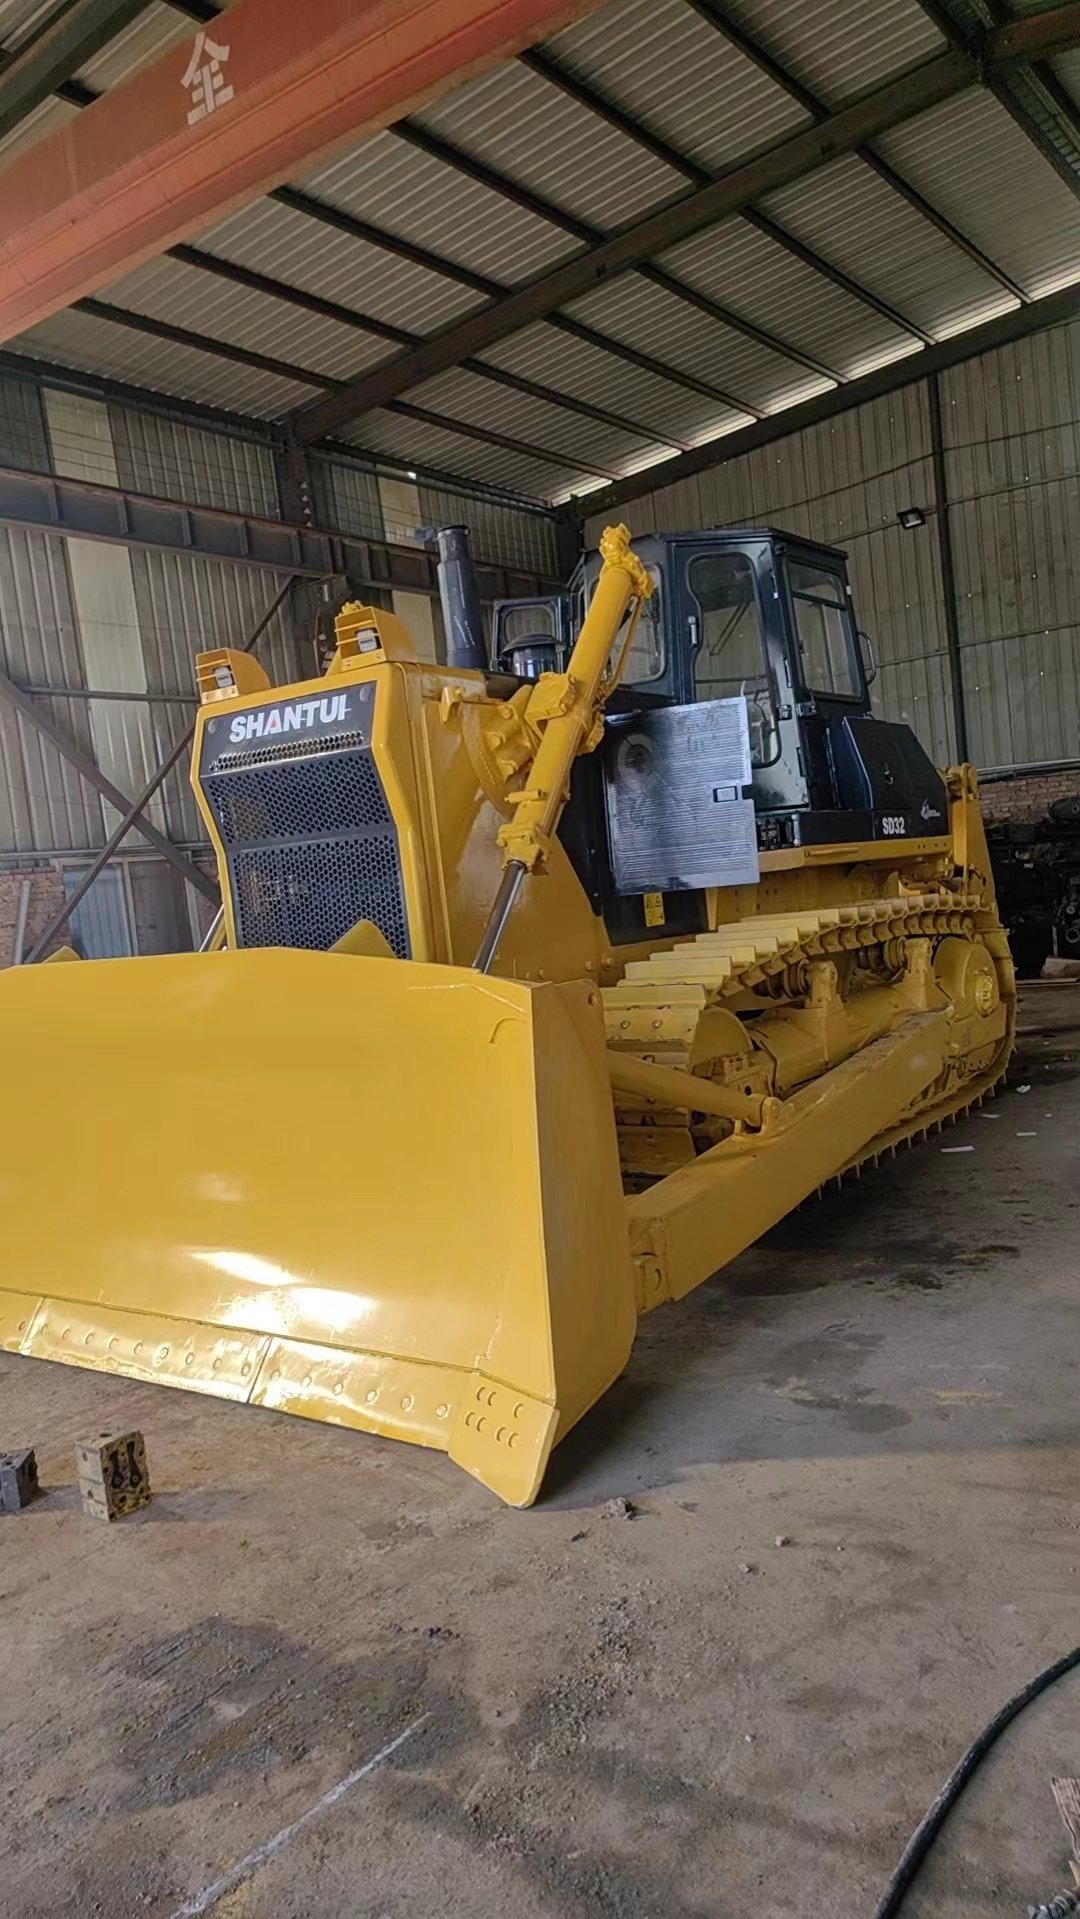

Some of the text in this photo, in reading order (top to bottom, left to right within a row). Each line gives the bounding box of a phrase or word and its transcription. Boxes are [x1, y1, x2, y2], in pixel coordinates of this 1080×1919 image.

[180, 31, 235, 126] 全
[229, 694, 348, 743] SHANTUI
[882, 816, 906, 835] SD32
